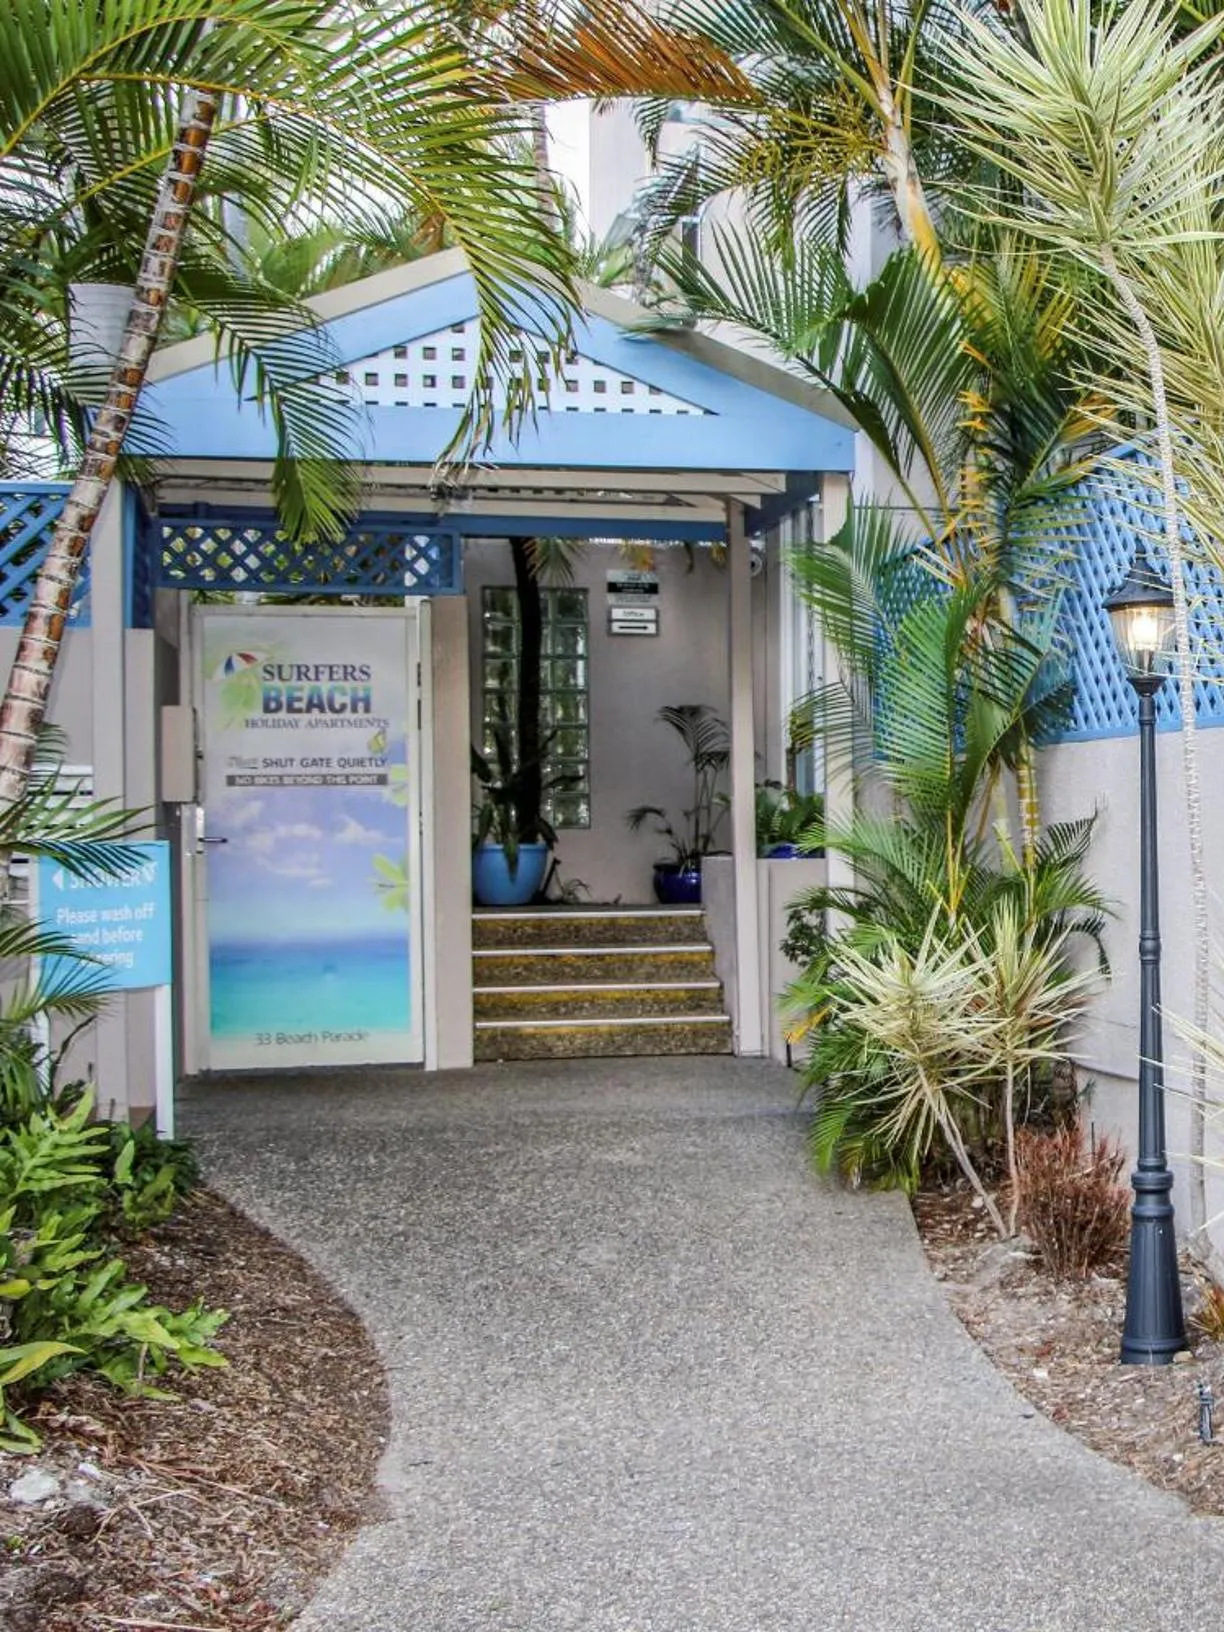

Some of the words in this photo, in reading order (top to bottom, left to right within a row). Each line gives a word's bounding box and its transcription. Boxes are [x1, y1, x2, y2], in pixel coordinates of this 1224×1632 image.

[262, 663, 372, 682] SURFERS
[262, 685, 372, 714] BEACH
[244, 717, 300, 729] HOLIDAY
[305, 716, 390, 729] APARTMENTS
[262, 757, 295, 768] SHUT
[301, 757, 333, 768] GATE
[337, 756, 388, 768] QUIETLY
[235, 775, 251, 785] NO
[283, 775, 323, 785] BEYOND
[350, 775, 377, 784] POINT
[56, 907, 98, 924] Please
[101, 904, 132, 921] wash
[134, 902, 156, 919] off
[101, 926, 143, 943] before
[254, 1032, 272, 1045] 33
[276, 1031, 319, 1045] Beach
[322, 1029, 370, 1043] Parade
